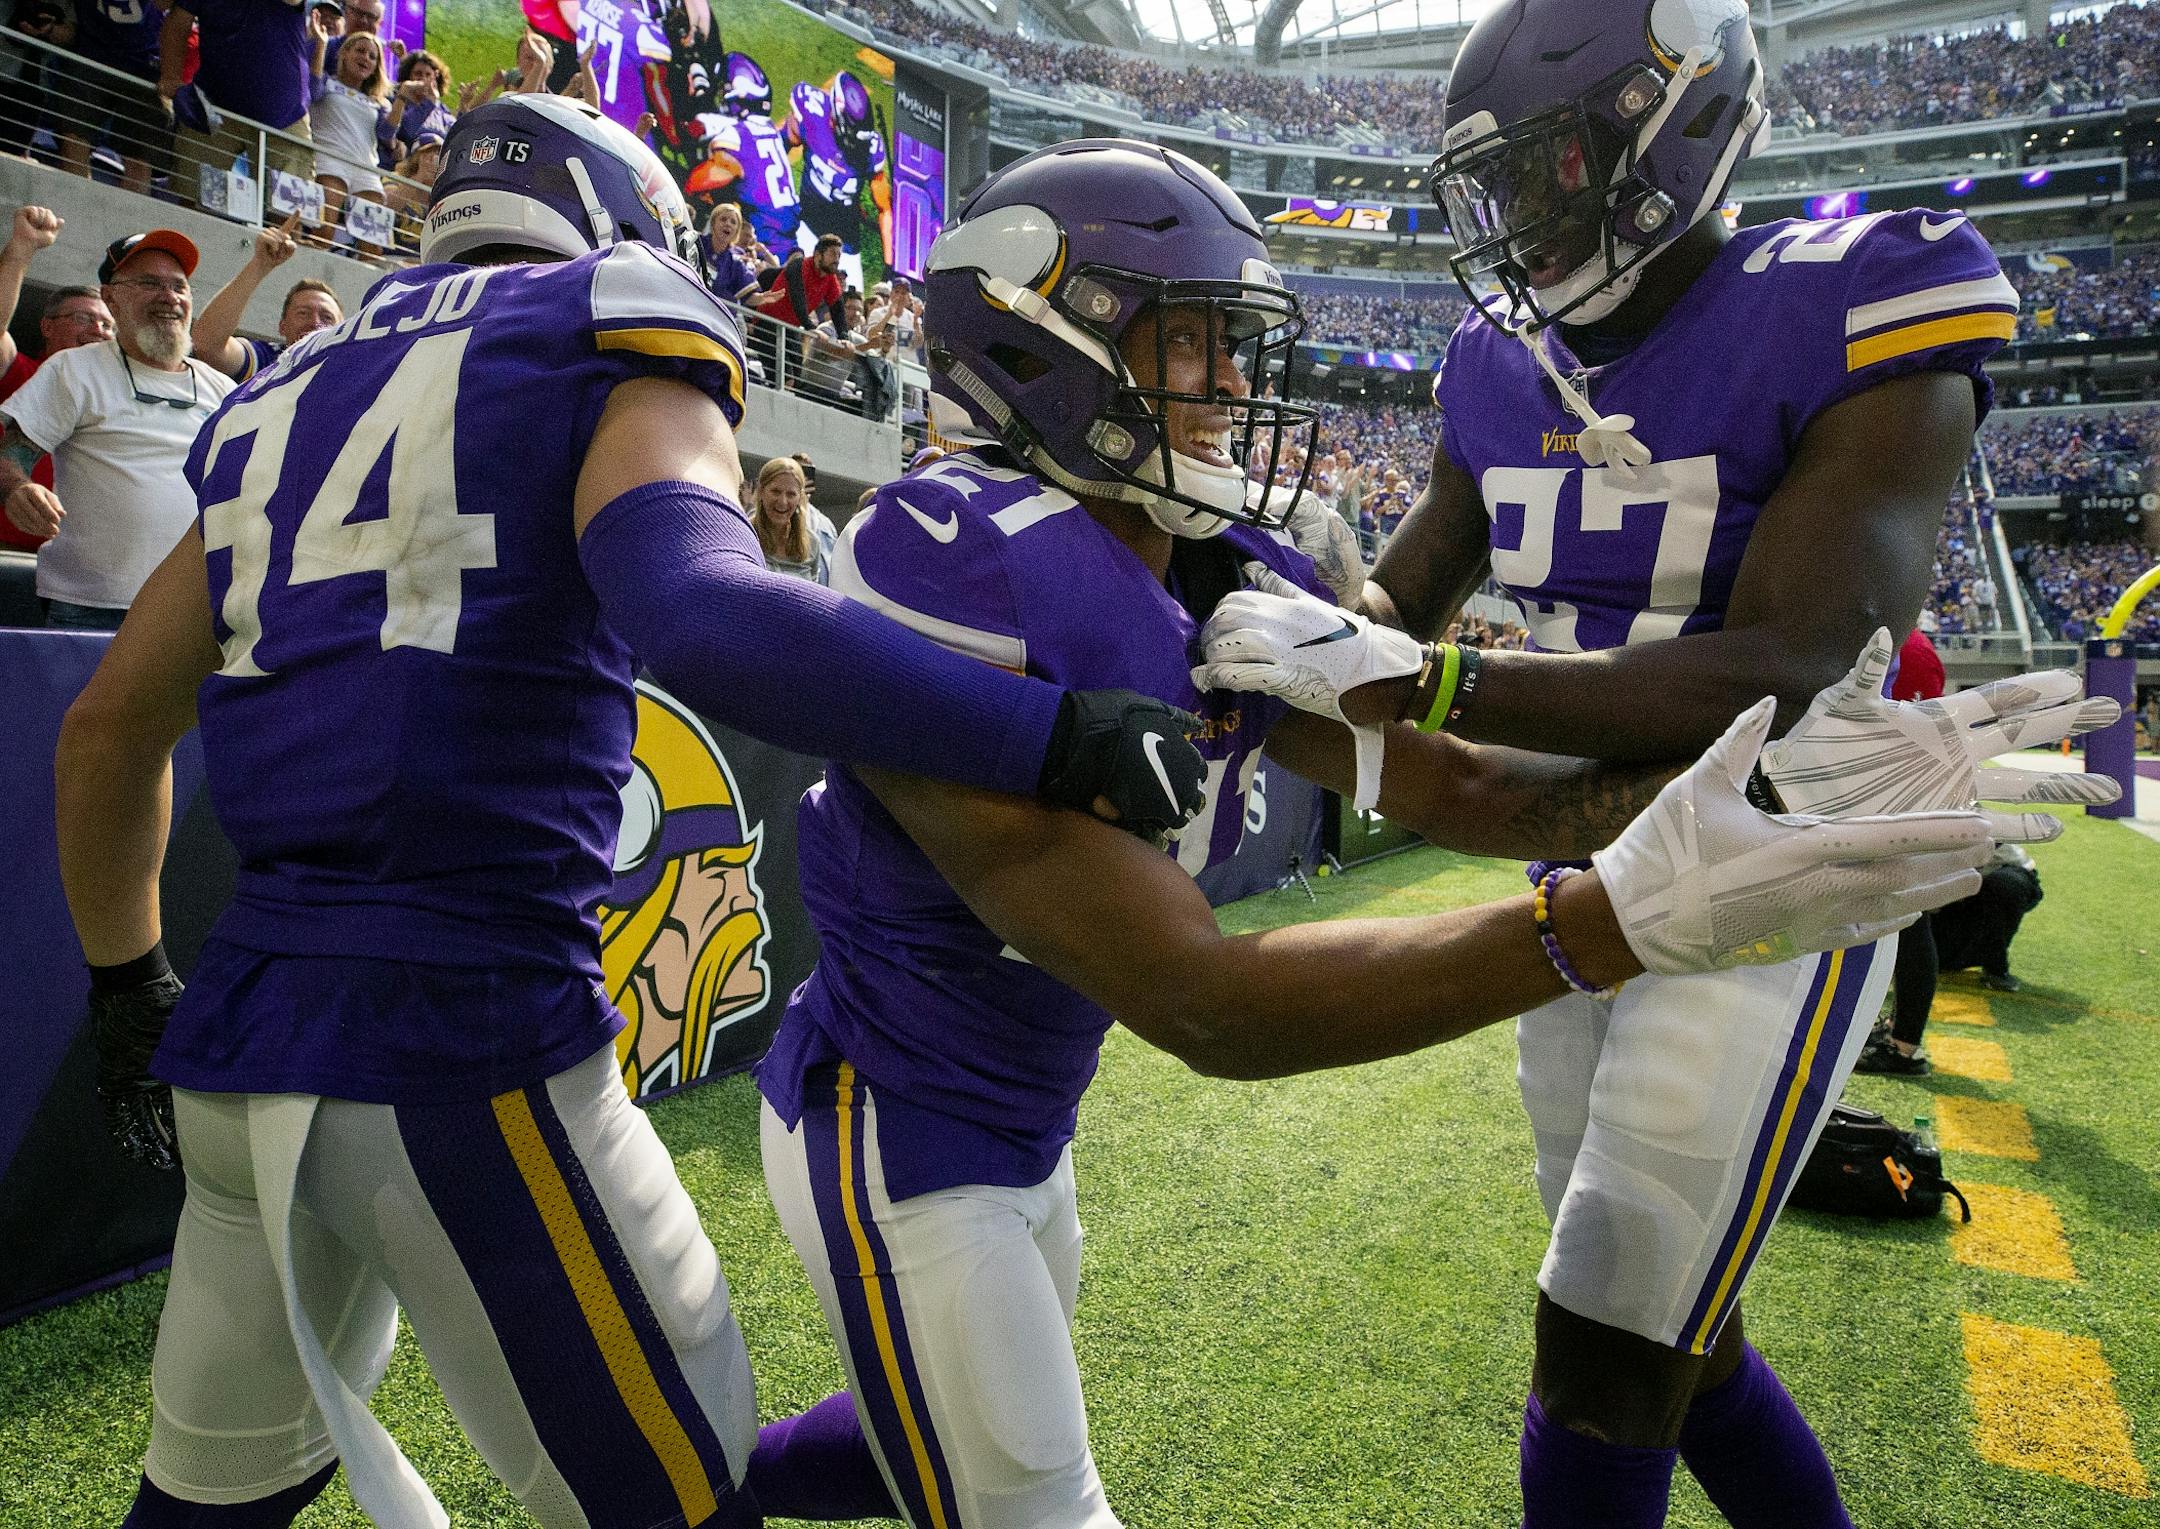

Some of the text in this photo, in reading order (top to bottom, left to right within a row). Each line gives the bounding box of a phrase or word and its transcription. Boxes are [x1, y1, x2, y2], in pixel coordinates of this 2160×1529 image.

[506, 141, 530, 163] TS
[431, 203, 482, 233] VIKINGS
[1541, 425, 1580, 458] VIKI
